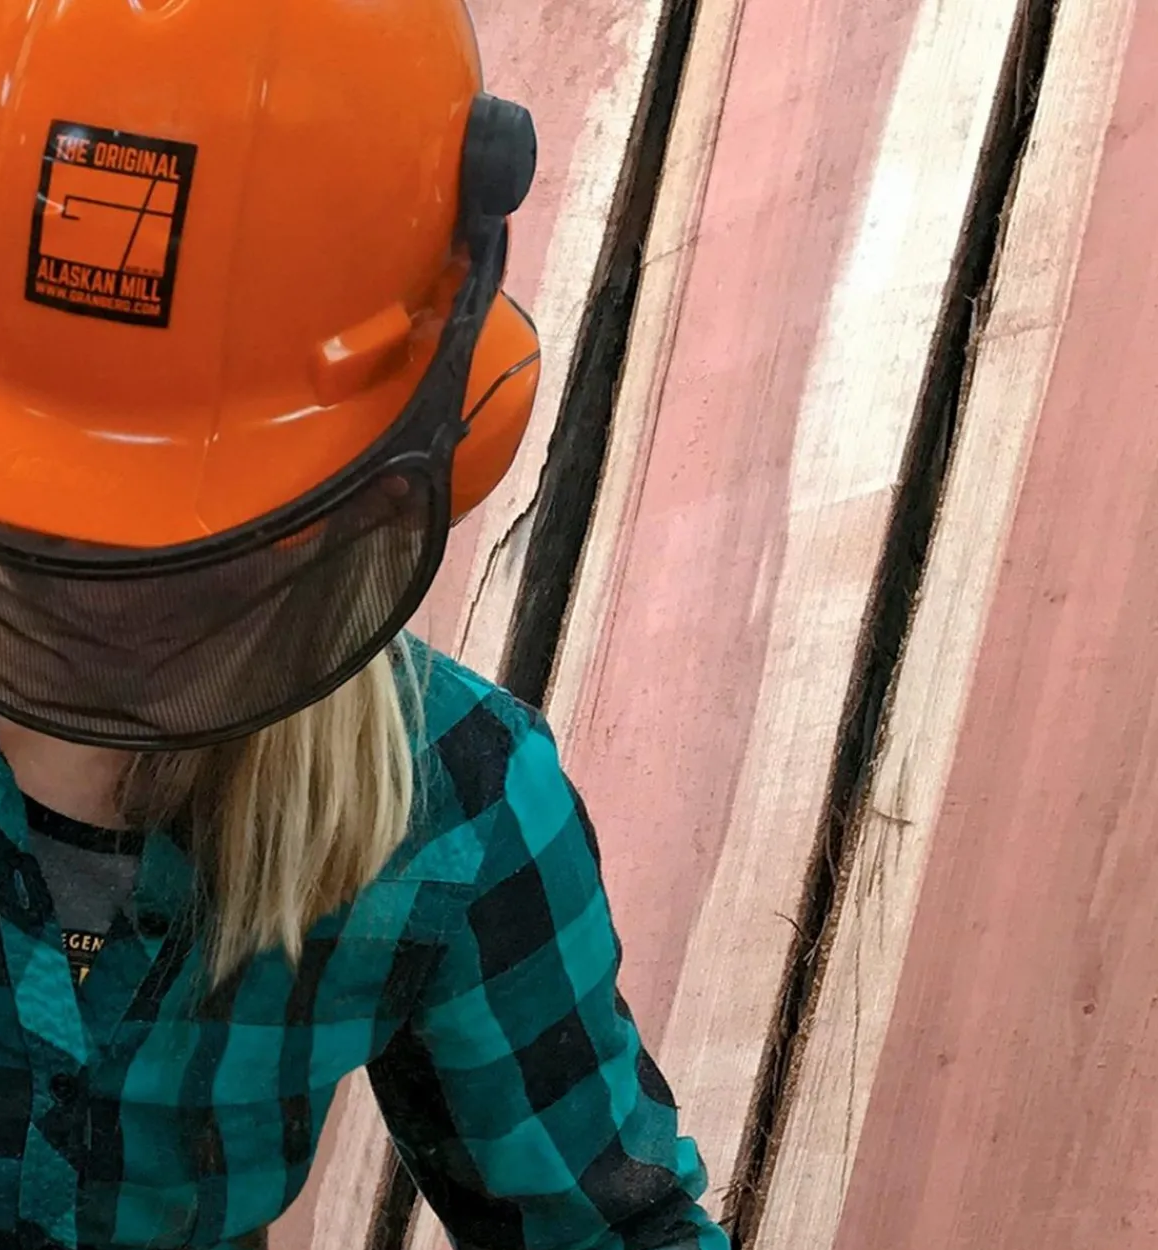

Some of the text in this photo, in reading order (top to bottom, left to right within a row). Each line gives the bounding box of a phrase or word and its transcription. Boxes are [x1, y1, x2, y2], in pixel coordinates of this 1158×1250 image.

[55, 134, 181, 179] THE ORIGINAL
[37, 258, 161, 302] ALASKAN MILL
